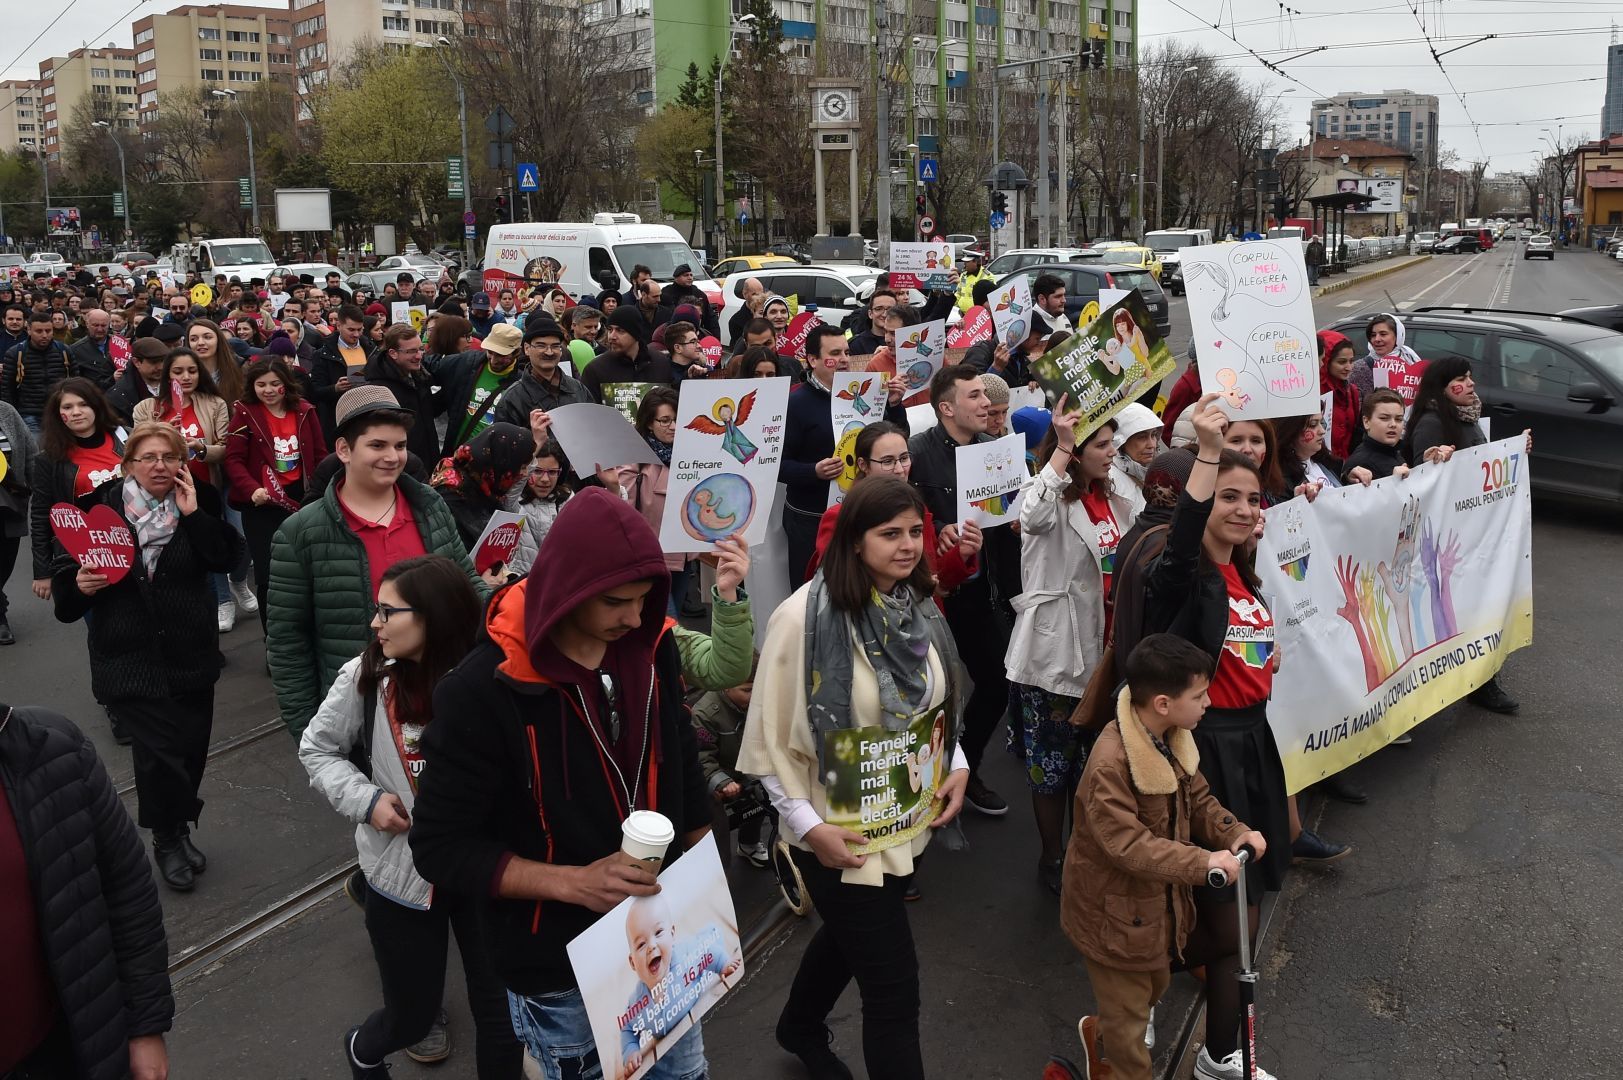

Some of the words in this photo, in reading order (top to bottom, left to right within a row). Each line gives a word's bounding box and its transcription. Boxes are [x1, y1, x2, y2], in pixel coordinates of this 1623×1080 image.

[501, 248, 518, 260] 8090
[1233, 251, 1279, 265] CORPUL
[1238, 274, 1288, 286] ALEGEREA
[1264, 284, 1286, 293] MEA
[791, 318, 820, 346] FEMEIE
[966, 312, 991, 338] FEMEIE
[1252, 330, 1290, 341] CORPUL
[776, 334, 790, 350] AȚĂ
[1055, 335, 1099, 370] Femeile
[1064, 348, 1098, 380] merită
[1259, 352, 1311, 364] ALEGEREA
[1071, 370, 1092, 392] mai
[1078, 378, 1103, 402] mult
[1404, 375, 1422, 385] FEM
[1083, 386, 1112, 413] decât
[1088, 390, 1124, 423] avortul
[762, 424, 781, 433] înger
[764, 435, 780, 443] vine
[772, 445, 778, 453] în
[678, 460, 690, 470] Cu
[692, 460, 722, 469] fiecare
[758, 456, 777, 465] lume
[676, 471, 701, 482] copil,
[1481, 454, 1520, 492] 2017
[966, 484, 999, 499] MARȘUL
[1455, 498, 1482, 513] MARȘUL
[1482, 490, 1504, 506] PENTRU
[50, 511, 88, 532] VIAȚĂ
[89, 530, 134, 547] FEMEIE
[488, 528, 518, 549] VIAȚĂ
[78, 553, 130, 568] FAMILIE
[88, 547, 112, 556] pentru
[1228, 627, 1253, 640] ARȘUL
[1304, 716, 1349, 754] AJUTĂ
[1350, 704, 1382, 736] MAMA
[1388, 677, 1419, 708] COPILUL!
[1421, 666, 1429, 684] EI
[1430, 648, 1465, 679] DEPIND
[1466, 639, 1485, 661] DE
[860, 730, 917, 756] Femeile
[860, 748, 908, 773] merită
[860, 771, 890, 790] mai
[861, 787, 896, 808] mult
[861, 802, 902, 824] decât
[862, 813, 912, 840] avortul
[617, 994, 650, 1030] Inima
[651, 972, 673, 999] mea
[632, 1016, 645, 1036] să
[646, 995, 669, 1022] bată
[671, 984, 681, 998] la
[682, 966, 696, 988] 16
[696, 952, 714, 978] zile
[639, 1027, 653, 1048] de
[654, 1018, 665, 1034] la
[665, 970, 714, 1022] concepție
